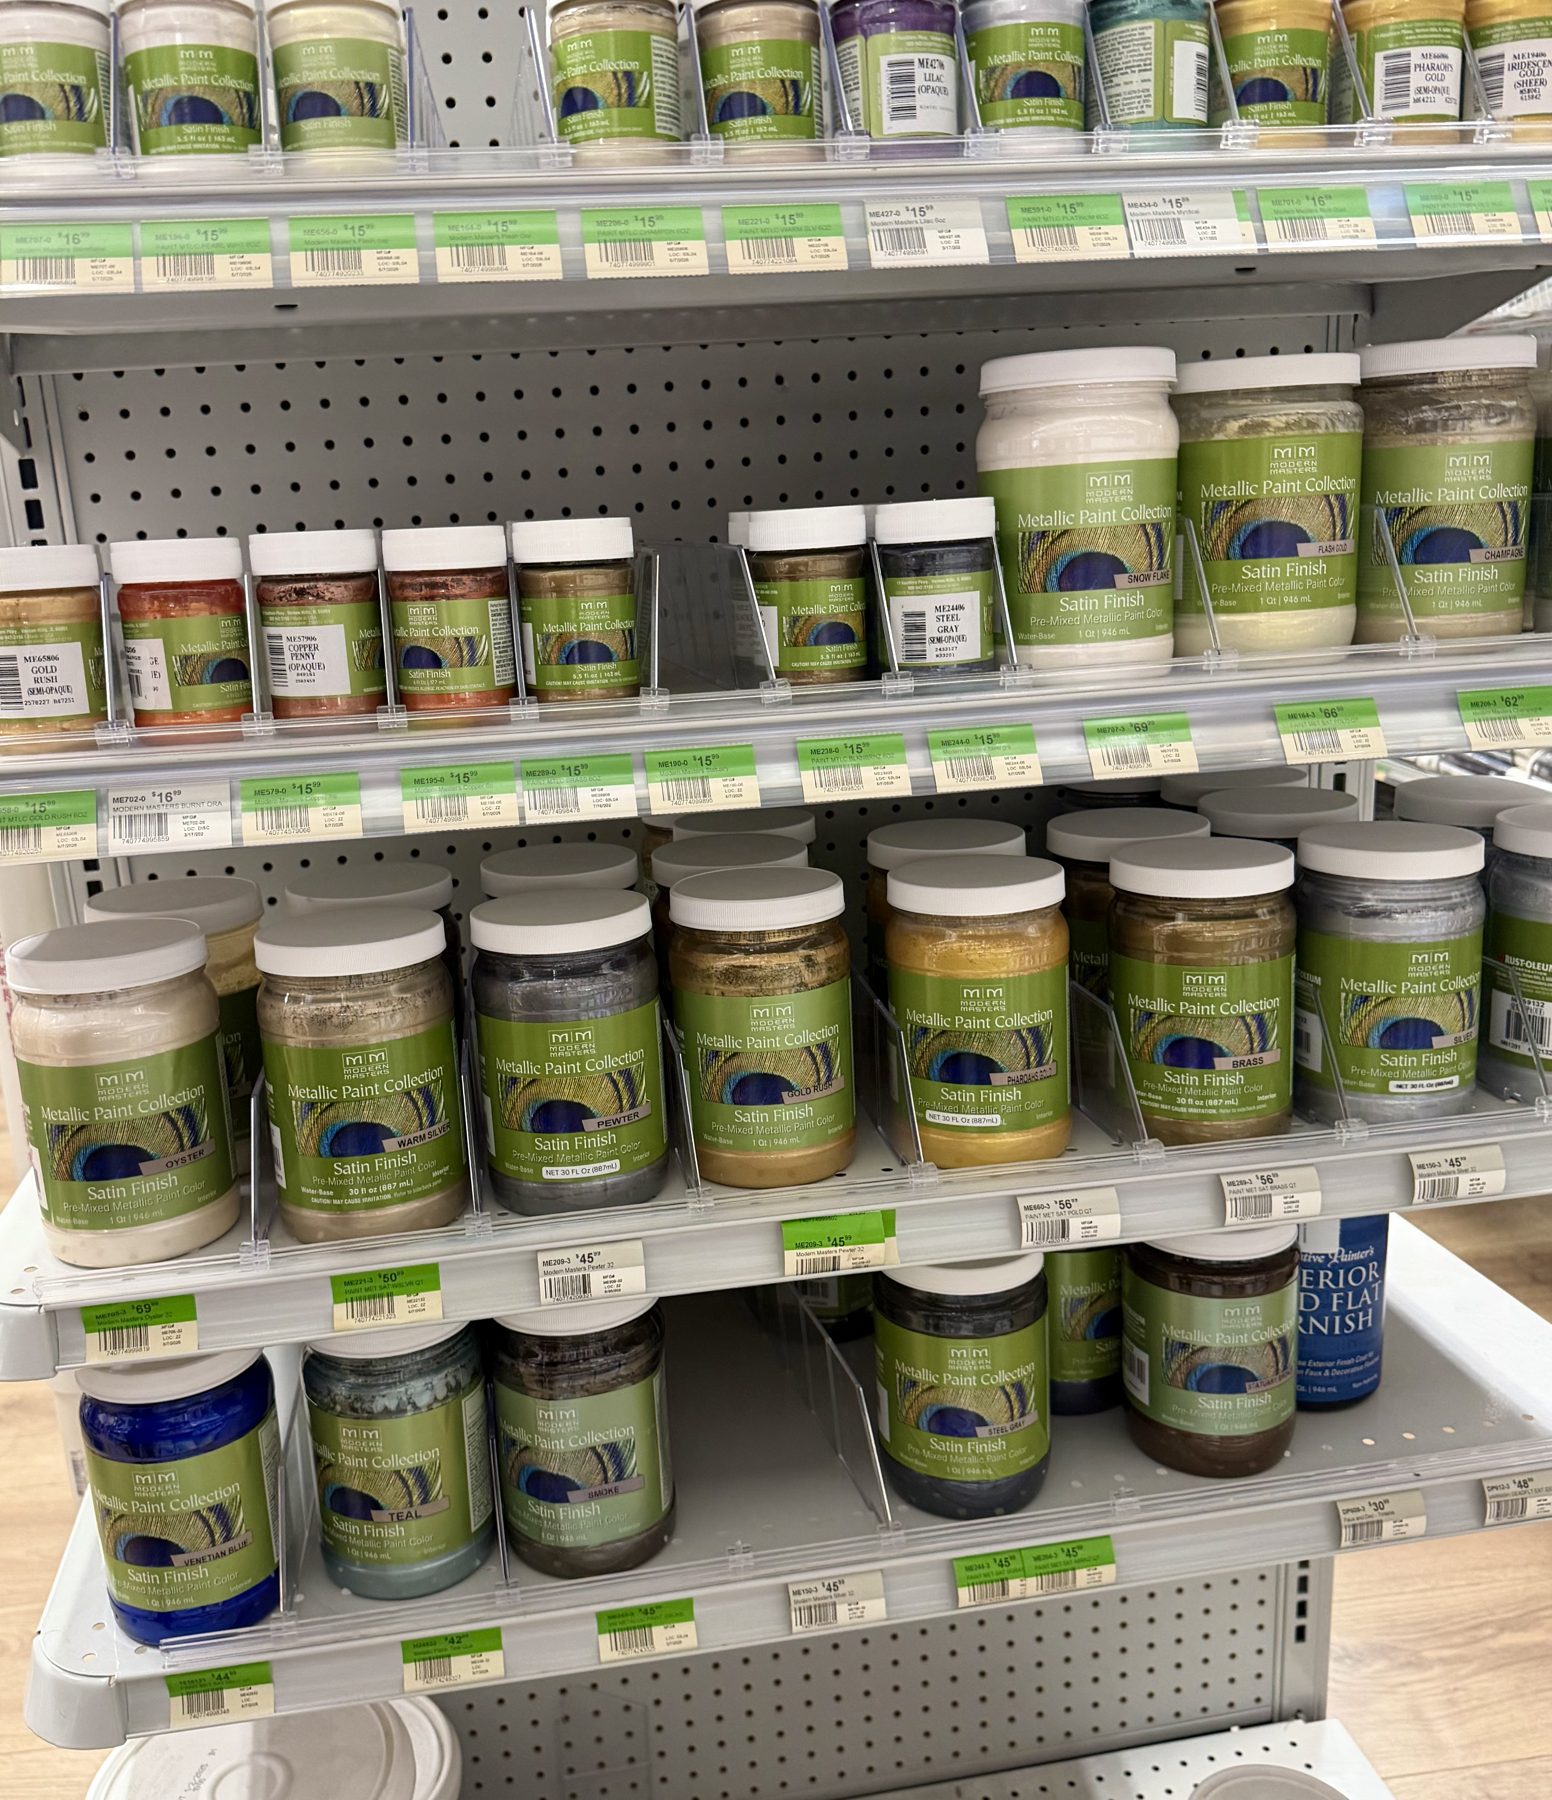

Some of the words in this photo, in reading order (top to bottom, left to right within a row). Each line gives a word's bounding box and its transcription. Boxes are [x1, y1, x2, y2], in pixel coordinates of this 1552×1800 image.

[566, 64, 588, 77] Paint
[590, 59, 640, 73] Collection
[1518, 66, 1544, 78] GOLD
[730, 68, 755, 82] Paint
[756, 67, 803, 79] Collection
[924, 72, 944, 83] LILAC
[1425, 72, 1446, 82] GOLD
[1513, 78, 1548, 89] (SHEER)
[868, 210, 900, 218] ME427-0
[1200, 479, 1259, 499] Metallic
[1263, 478, 1302, 495] Paint
[1305, 475, 1356, 492] Collection
[1375, 487, 1433, 505] Metallic
[1438, 487, 1474, 502] Paint
[1479, 482, 1528, 500] Collection
[1018, 509, 1075, 528] Metallic
[1080, 508, 1117, 524] Paint
[1121, 503, 1172, 521] Collection
[1127, 573, 1151, 584] SNOW
[1152, 571, 1170, 582] FLAKE
[791, 603, 827, 616] Metallic
[828, 602, 848, 614] Paint
[935, 613, 961, 623] STEEL
[408, 626, 430, 637] Paint
[431, 625, 479, 636] Collection
[936, 624, 960, 635] GRAY
[286, 634, 318, 643] ME57906
[287, 643, 320, 653] COPPER
[290, 651, 316, 662] PENNY
[30, 664, 58, 674] GOLD
[288, 661, 326, 672] (OPAQUE)
[33, 675, 58, 684] RUSH
[941, 738, 970, 747] ME244-0
[658, 759, 688, 768] ME190-0
[525, 768, 557, 777] ME289-0
[413, 776, 445, 785] ME195-0
[253, 787, 287, 797] ME579-0
[112, 795, 146, 805] ME702-0
[112, 805, 145, 813] MODERN
[146, 803, 180, 812] MASTERS
[181, 801, 206, 809] BURNT
[1340, 976, 1397, 994] Metallic
[1400, 979, 1436, 994] Paint
[1439, 970, 1481, 992] Collection
[1127, 993, 1175, 1013] Metallic
[1179, 1001, 1216, 1016] Paint
[1219, 996, 1280, 1016] Collection
[906, 1007, 951, 1028] Metallic
[955, 1015, 991, 1029] Paint
[994, 1009, 1053, 1029] Collection
[695, 1032, 742, 1049] Metallic
[746, 1033, 781, 1049] Paint
[784, 1023, 839, 1046] Collection
[1453, 1032, 1473, 1045] SILVER
[495, 1057, 541, 1075] Metallic
[545, 1060, 582, 1075] Paint
[585, 1048, 645, 1072] Collection
[1232, 1056, 1264, 1069] BRASS
[288, 1083, 338, 1100] Metallic
[342, 1084, 380, 1099] Paint
[384, 1065, 444, 1093] Collection
[787, 1088, 812, 1098] GOLD
[813, 1082, 833, 1092] RUSH
[41, 1105, 90, 1122] Metallic
[94, 1103, 133, 1120] Paint
[137, 1084, 205, 1114] Collection
[1176, 1097, 1186, 1105] 30
[597, 1111, 640, 1129] PEWTER
[928, 1113, 941, 1122] NET
[941, 1114, 951, 1122] 30
[951, 1115, 960, 1123] FL
[960, 1116, 971, 1124] Oz
[971, 1116, 998, 1125] (887mL)
[397, 1131, 427, 1149] WARM
[427, 1121, 451, 1139] SILVER
[165, 1148, 205, 1169] OYSTER
[545, 1169, 559, 1177] NET
[560, 1168, 571, 1176] 30
[571, 1168, 580, 1176] FL
[581, 1167, 591, 1175] Oz
[591, 1162, 618, 1174] (887mL)
[1416, 1161, 1442, 1170] ME150-3
[349, 1187, 360, 1196] 30
[368, 1186, 378, 1194] oz
[379, 1181, 397, 1194] (887
[795, 1240, 823, 1249] ME209-3
[816, 1248, 838, 1256] Masters
[542, 1257, 571, 1267] ME209-3
[543, 1268, 564, 1276] Modern
[564, 1265, 586, 1273] Masters
[606, 1261, 614, 1269] 32
[1331, 1279, 1382, 1312] FLAT
[895, 1358, 939, 1384] Metallic
[943, 1372, 977, 1387] Paint
[980, 1361, 1036, 1385] Collection
[1197, 1396, 1233, 1410] Satin
[1236, 1392, 1272, 1410] Finish
[988, 1426, 1008, 1436] STEEL
[338, 1453, 369, 1468] Paint
[371, 1447, 441, 1469] Collection
[588, 1485, 620, 1499] SMOKE
[388, 1510, 423, 1522] TEAL
[183, 1551, 227, 1566] VENETIAN
[228, 1539, 249, 1555] BLUE
